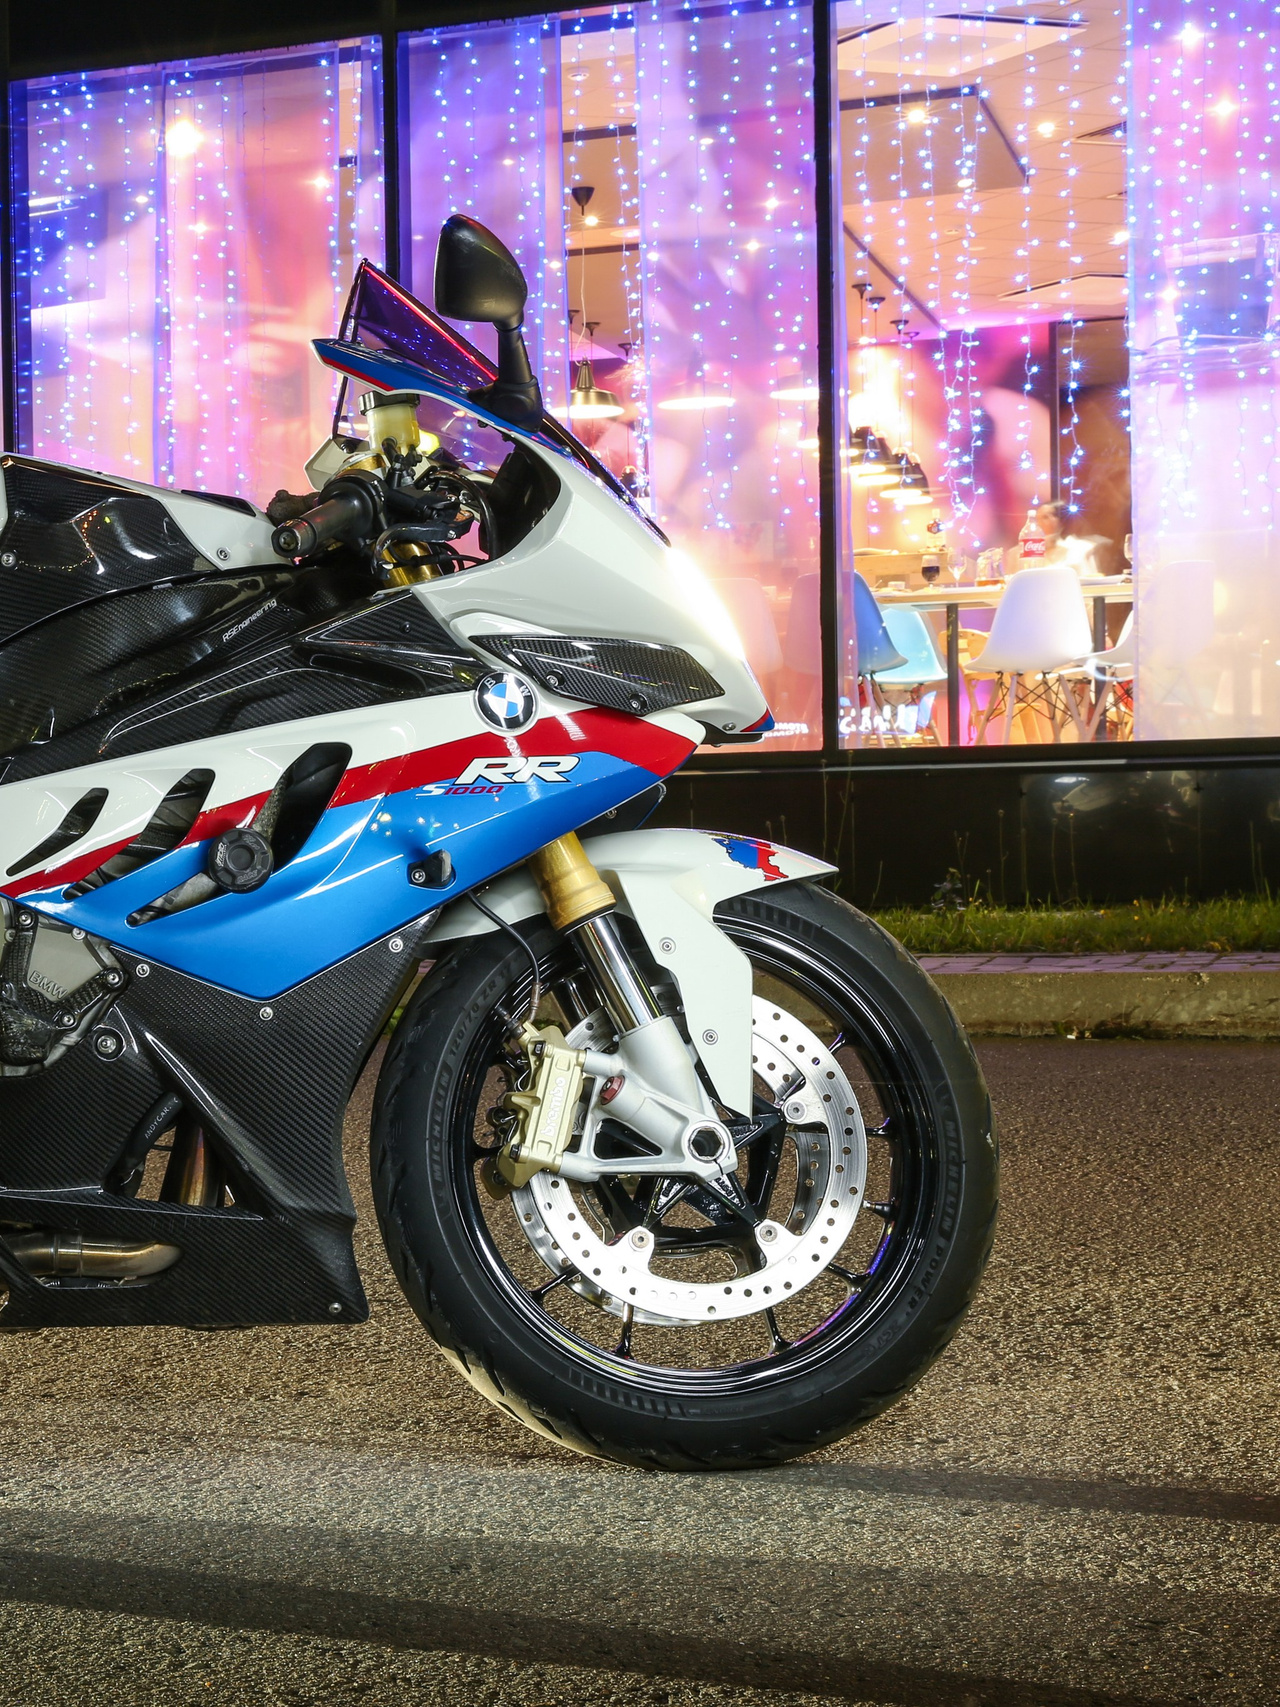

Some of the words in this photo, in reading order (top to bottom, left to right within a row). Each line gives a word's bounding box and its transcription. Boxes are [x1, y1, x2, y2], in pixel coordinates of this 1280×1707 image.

[222, 599, 278, 642] RSEngineering
[415, 783, 504, 797] S1000
[454, 754, 580, 785] RR
[29, 970, 68, 999] BMW
[431, 1071, 450, 1182] MICHELIN
[449, 1002, 480, 1057] 120/70
[480, 980, 497, 1001] ZR
[540, 1076, 566, 1137] brembo
[941, 1120, 960, 1233] MICHELIN
